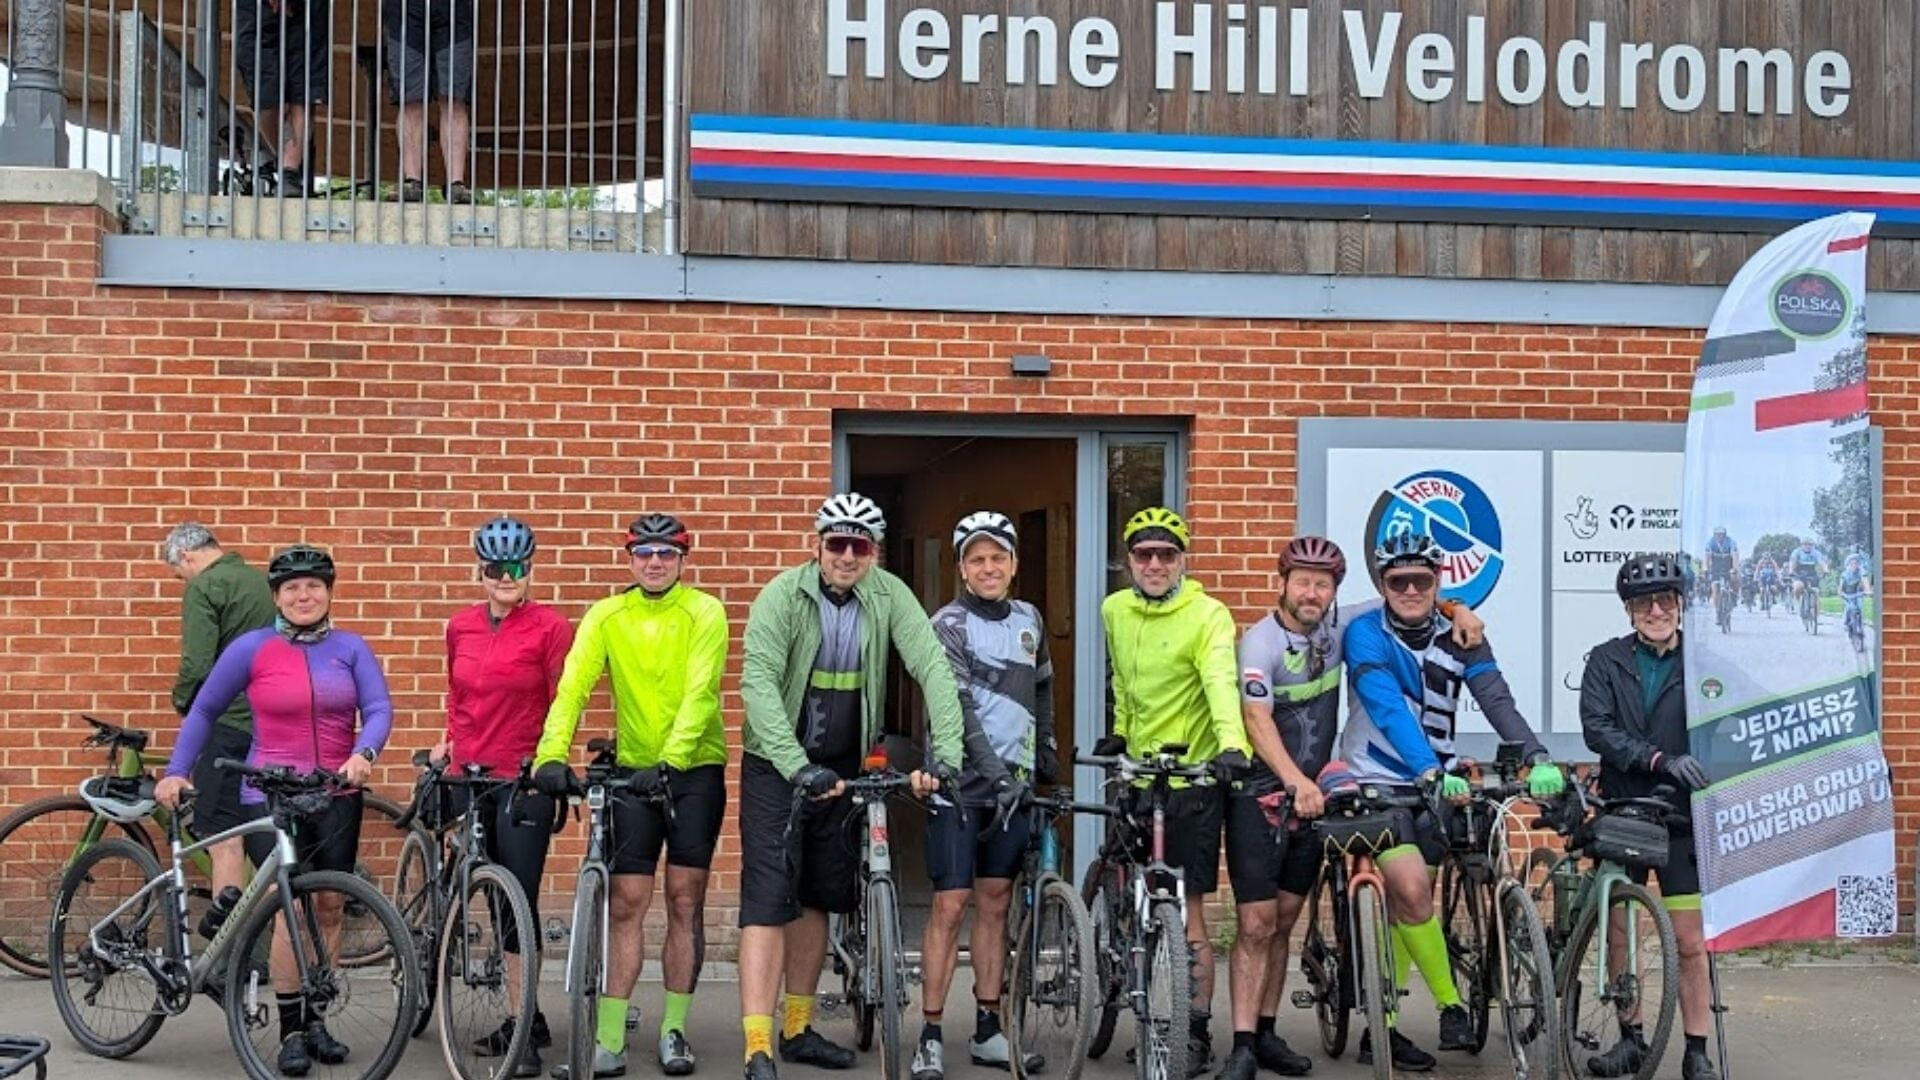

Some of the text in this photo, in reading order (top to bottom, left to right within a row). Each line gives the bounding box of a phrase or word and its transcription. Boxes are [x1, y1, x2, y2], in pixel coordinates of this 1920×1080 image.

[827, 0, 1853, 118] Herne Hill Velodrome
[1778, 294, 1842, 312] POLSKA
[1402, 479, 1462, 504] HERNE
[1640, 508, 1679, 518] SPORT
[1640, 519, 1681, 529] ENGLA
[1436, 549, 1487, 583] HILL
[1563, 551, 1632, 563] LOTTERY
[1731, 687, 1859, 742] JEDZIESZ
[1749, 711, 1856, 762] Z NAMI?
[1715, 783, 1808, 832] POLSKA
[1718, 787, 1864, 855] ROWEROWA
